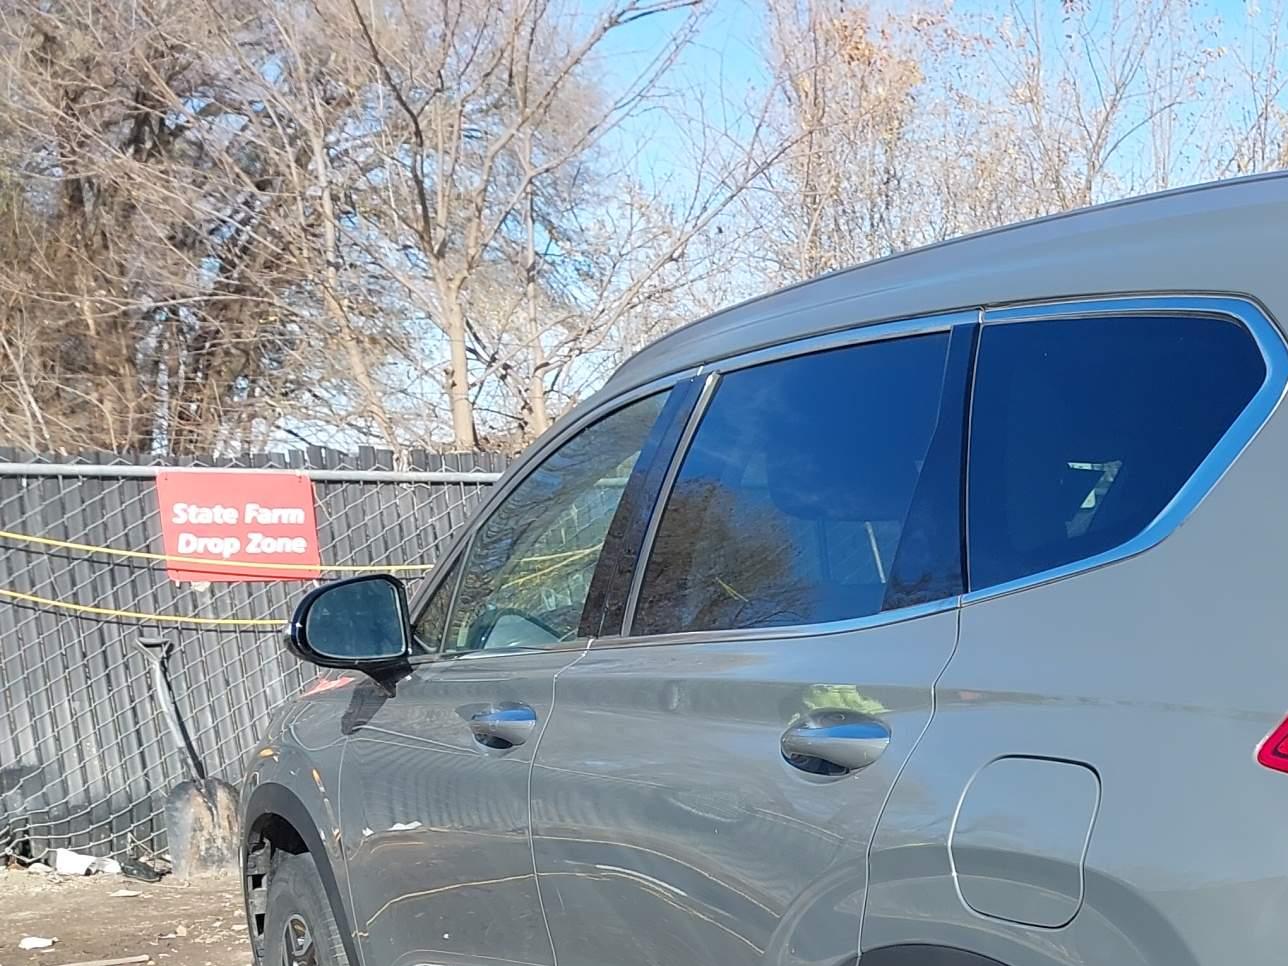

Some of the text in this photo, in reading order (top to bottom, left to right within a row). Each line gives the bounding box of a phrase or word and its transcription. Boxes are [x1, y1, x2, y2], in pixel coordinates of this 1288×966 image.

[172, 502, 305, 525] State Farm
[177, 532, 307, 560] Drop Zone
